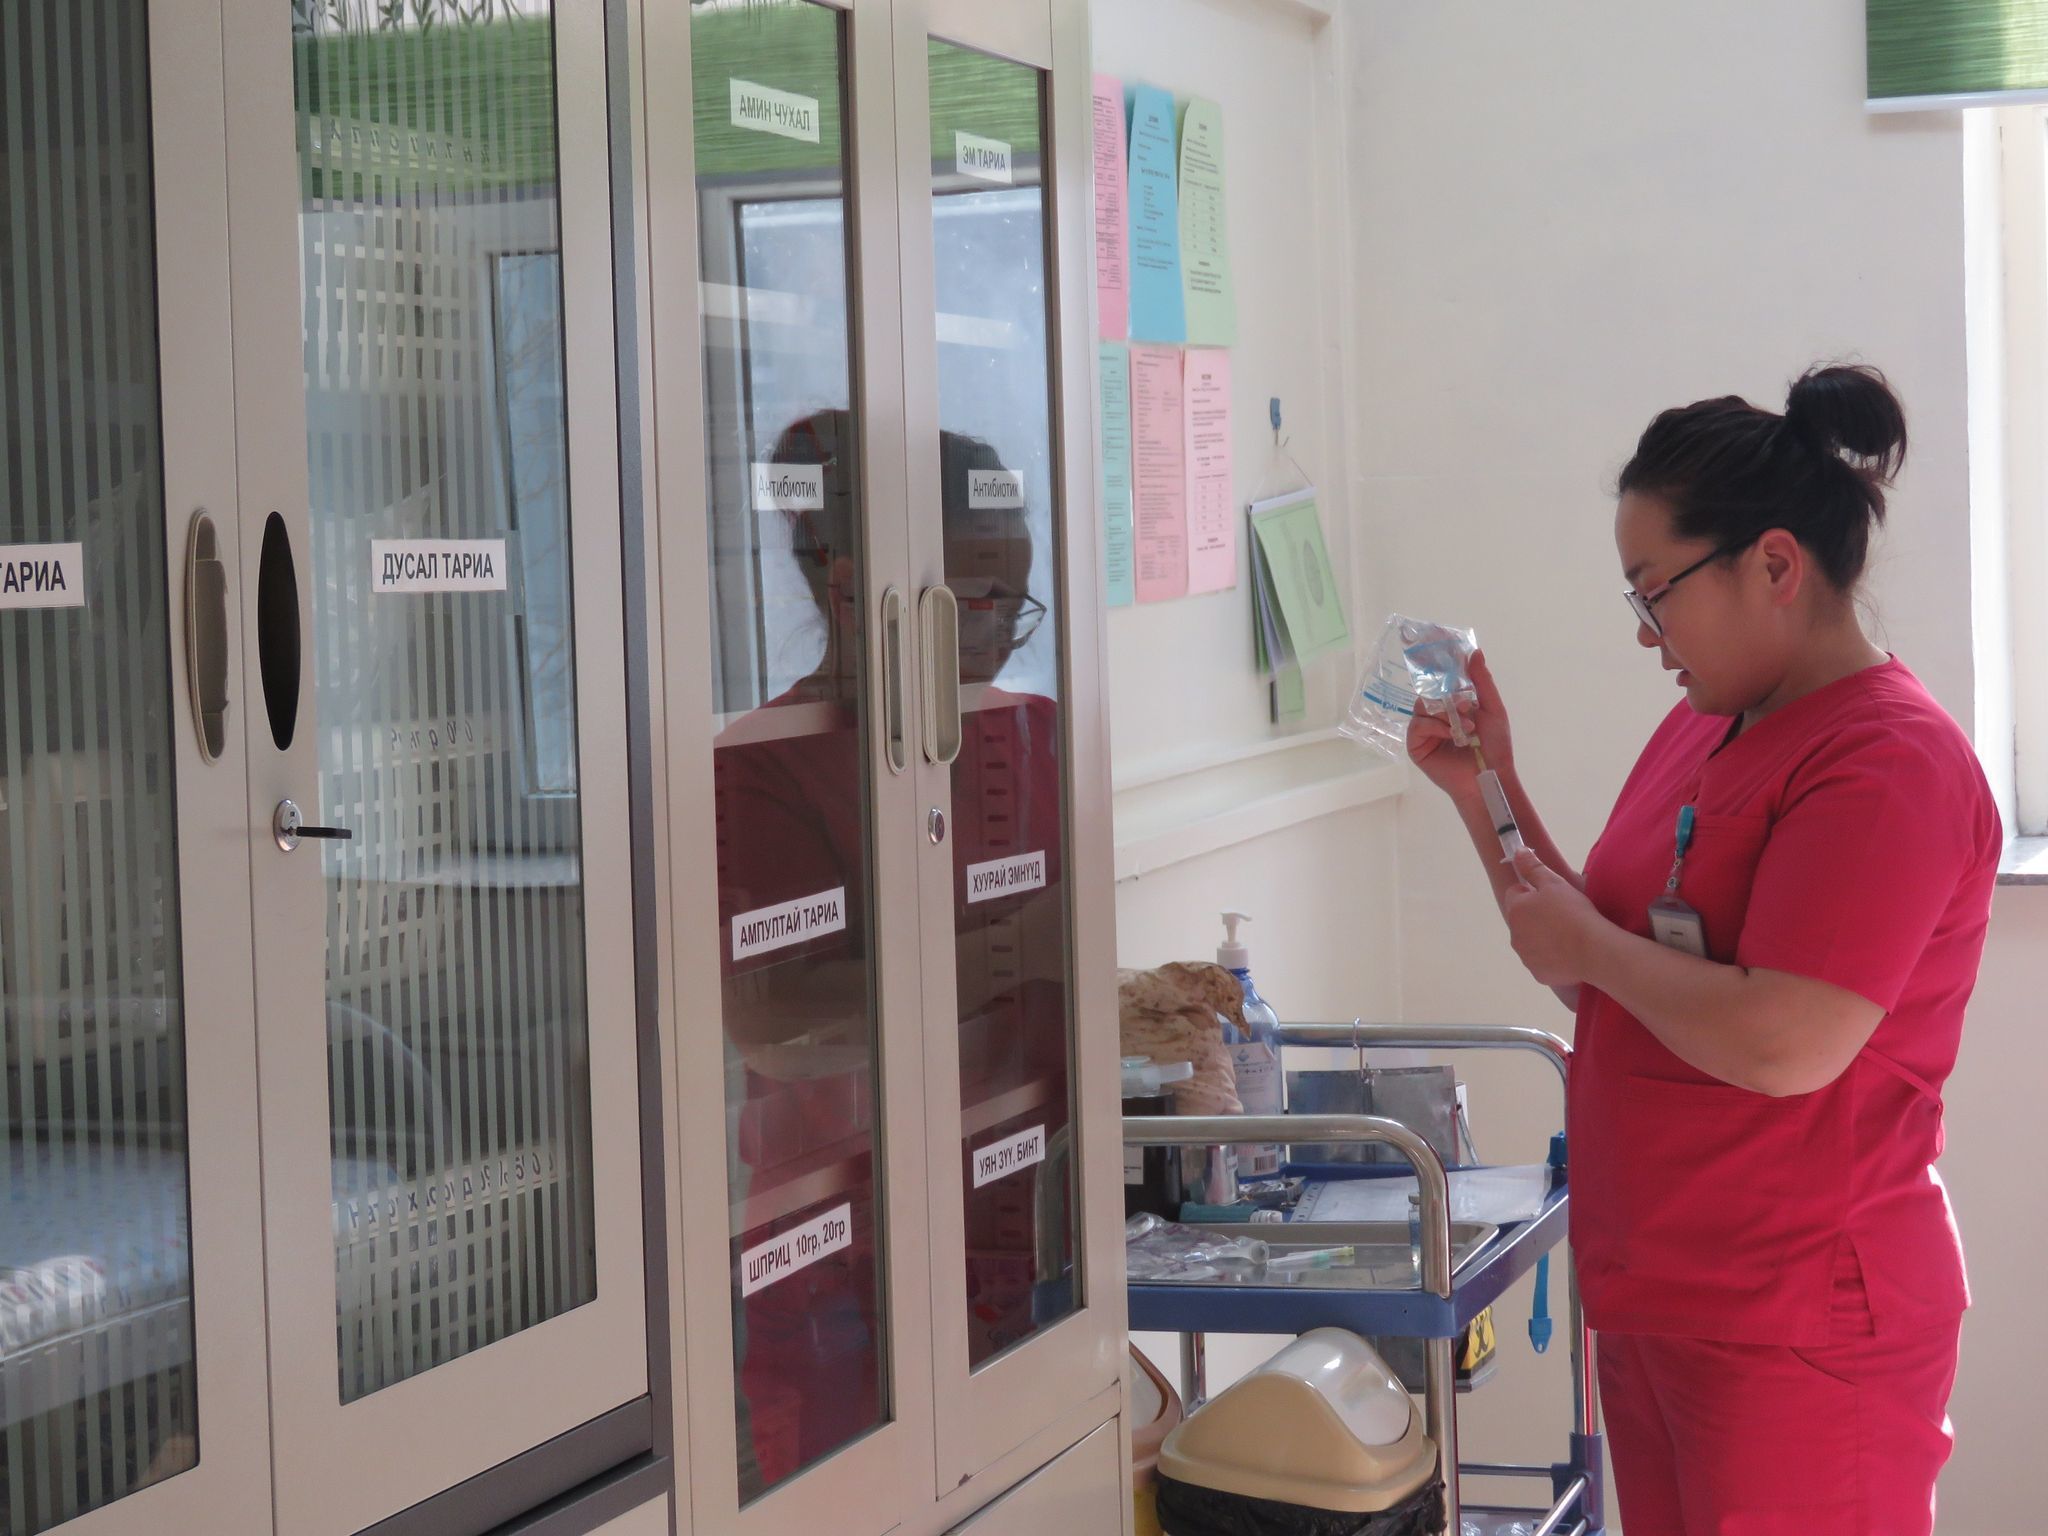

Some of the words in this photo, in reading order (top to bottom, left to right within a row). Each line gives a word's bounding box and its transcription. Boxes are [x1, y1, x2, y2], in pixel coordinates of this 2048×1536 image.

[740, 94, 771, 123] АМИН
[774, 102, 810, 131] ЧУХАЛ
[962, 145, 976, 166] ЭМ
[977, 148, 1006, 172] ТАРИА
[758, 474, 817, 498] Антибиотик
[973, 477, 1019, 498] Антибиотик
[0, 560, 67, 594] АРИА
[382, 552, 438, 585] ДУСАЛ
[441, 552, 495, 579] ТАРИА
[973, 864, 1006, 894] ХУУРАЙ
[740, 905, 801, 948] АМПУЛТАЙ
[803, 900, 839, 929] ТАРИА
[979, 1153, 997, 1178] УЯН
[1016, 1136, 1039, 1162] БИНТ
[749, 1242, 791, 1283] ШПРИЦ
[796, 1234, 821, 1258] 10гр,
[822, 1220, 846, 1244] 20гр
